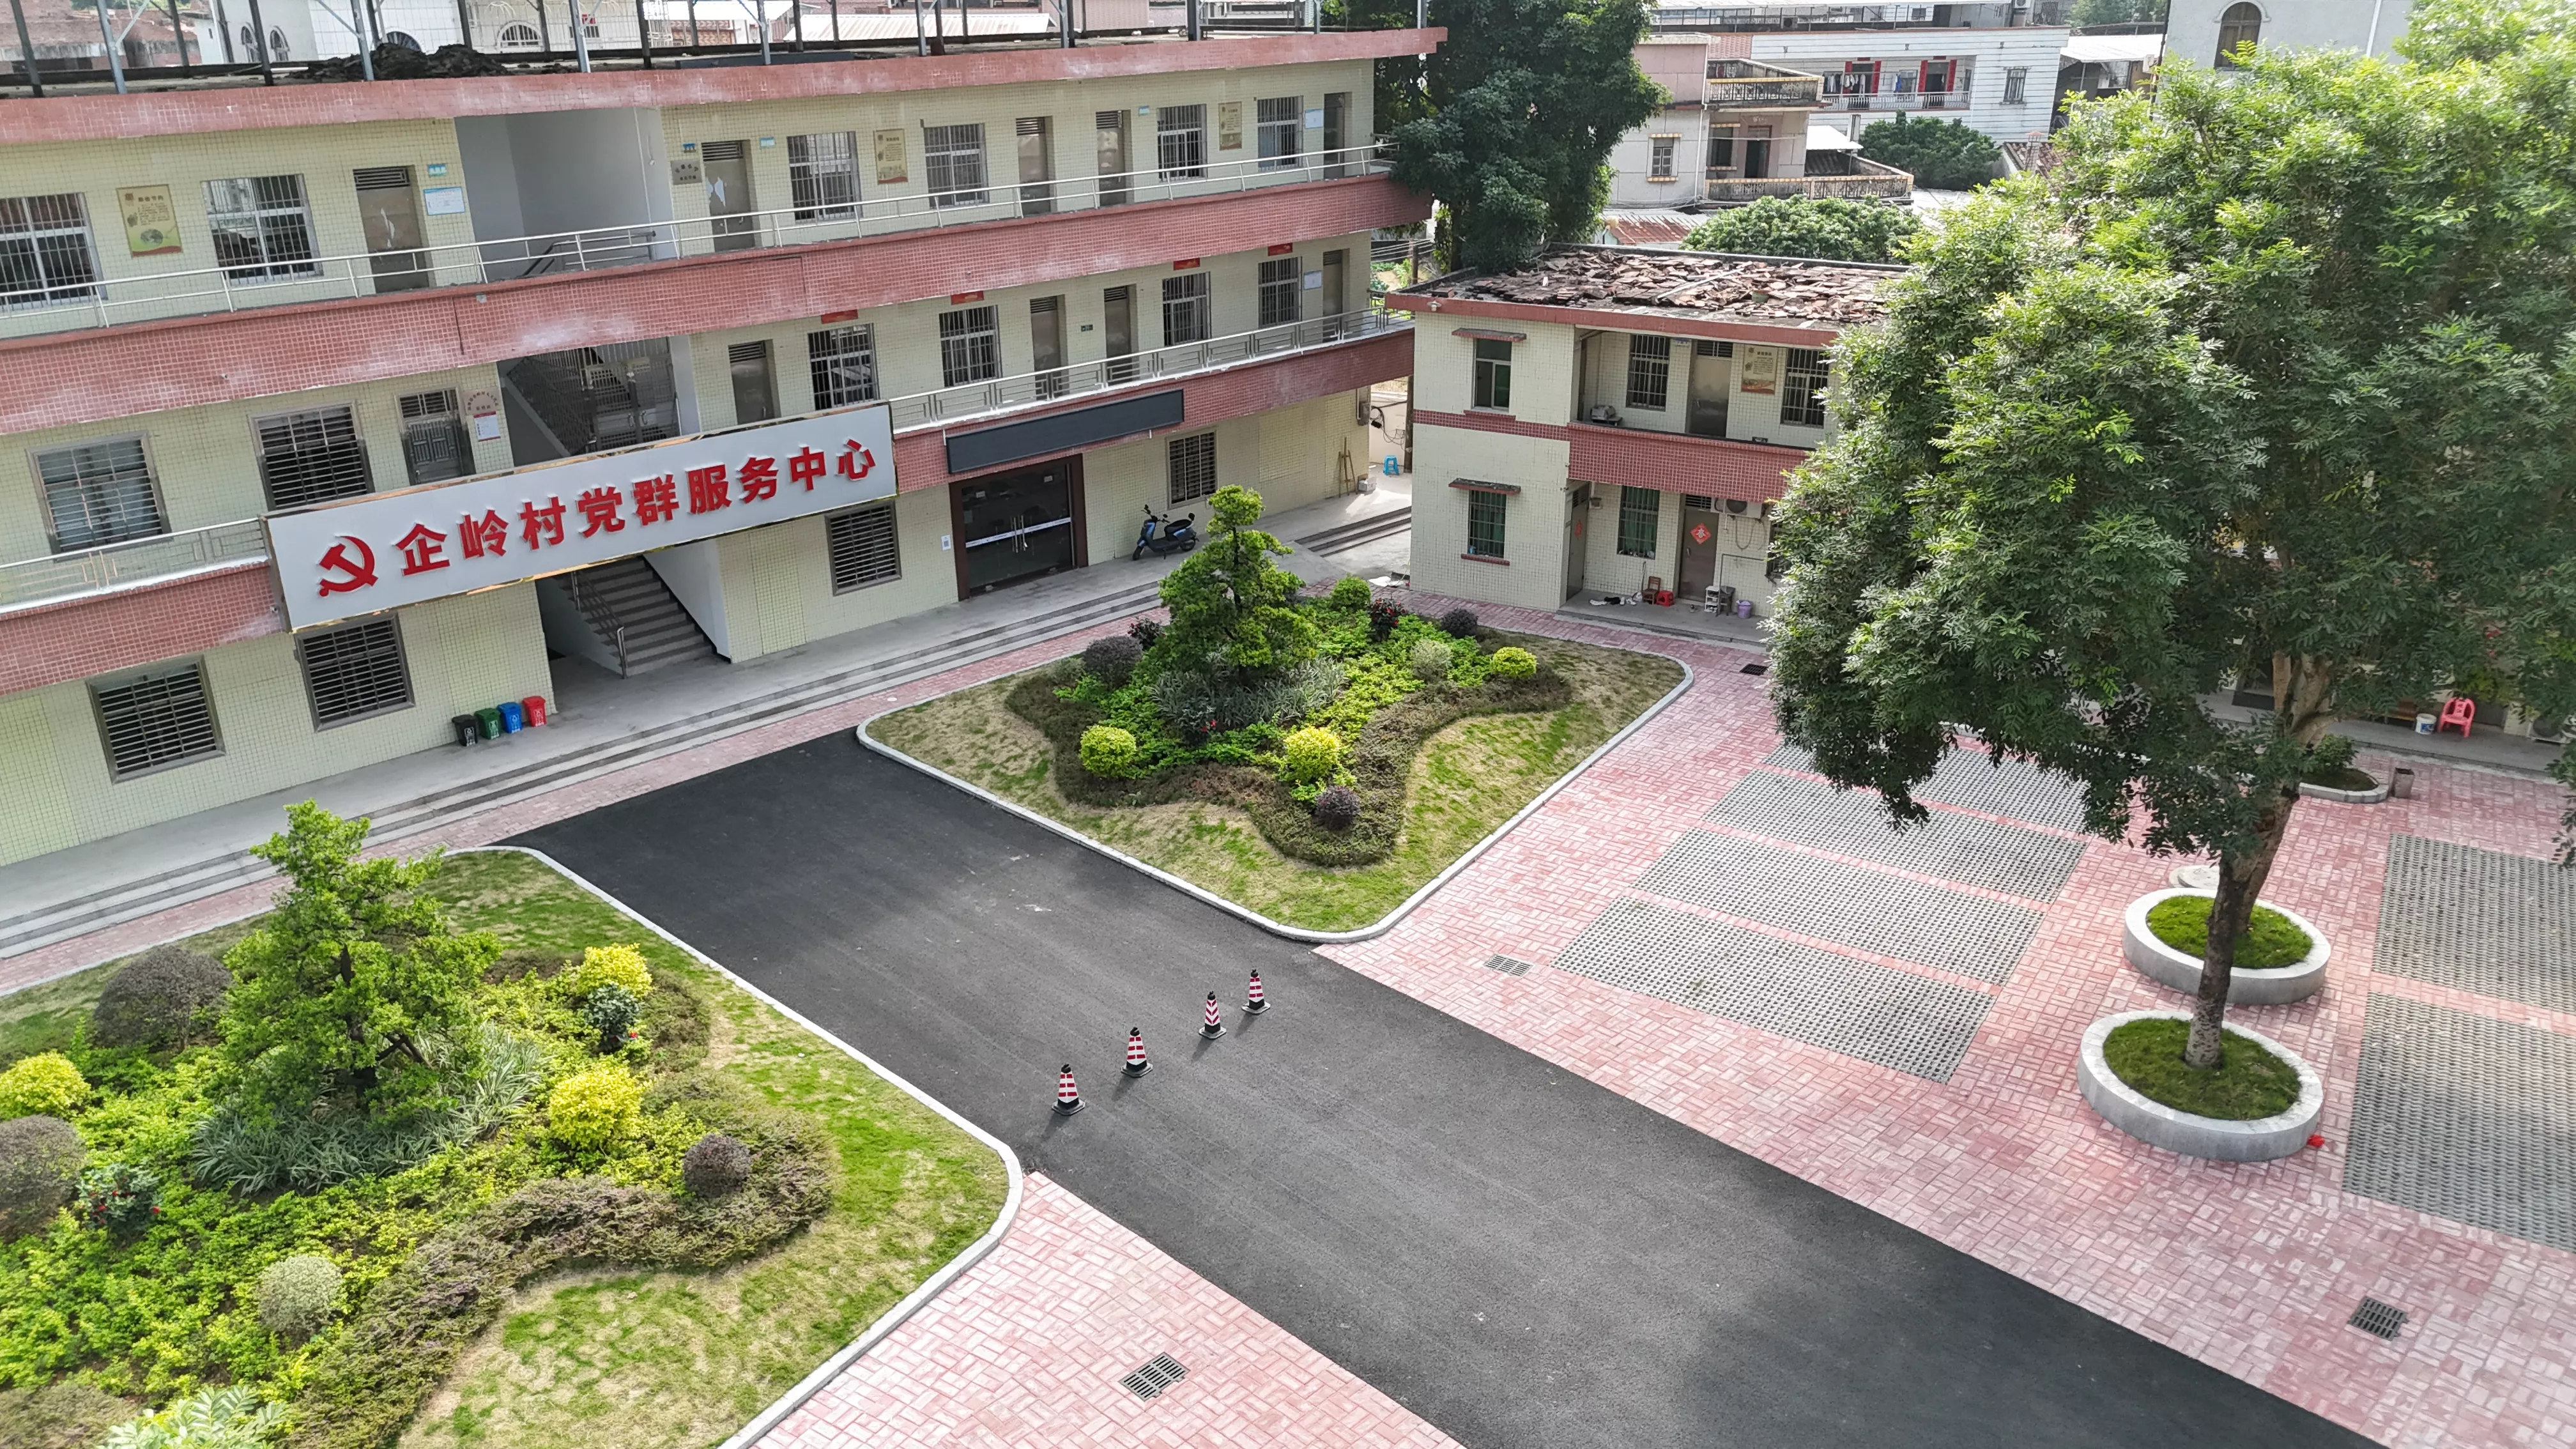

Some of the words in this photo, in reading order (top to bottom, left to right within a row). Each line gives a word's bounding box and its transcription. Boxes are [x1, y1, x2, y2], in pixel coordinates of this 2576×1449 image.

[395, 439, 876, 577] 企岭村党群服务中心
